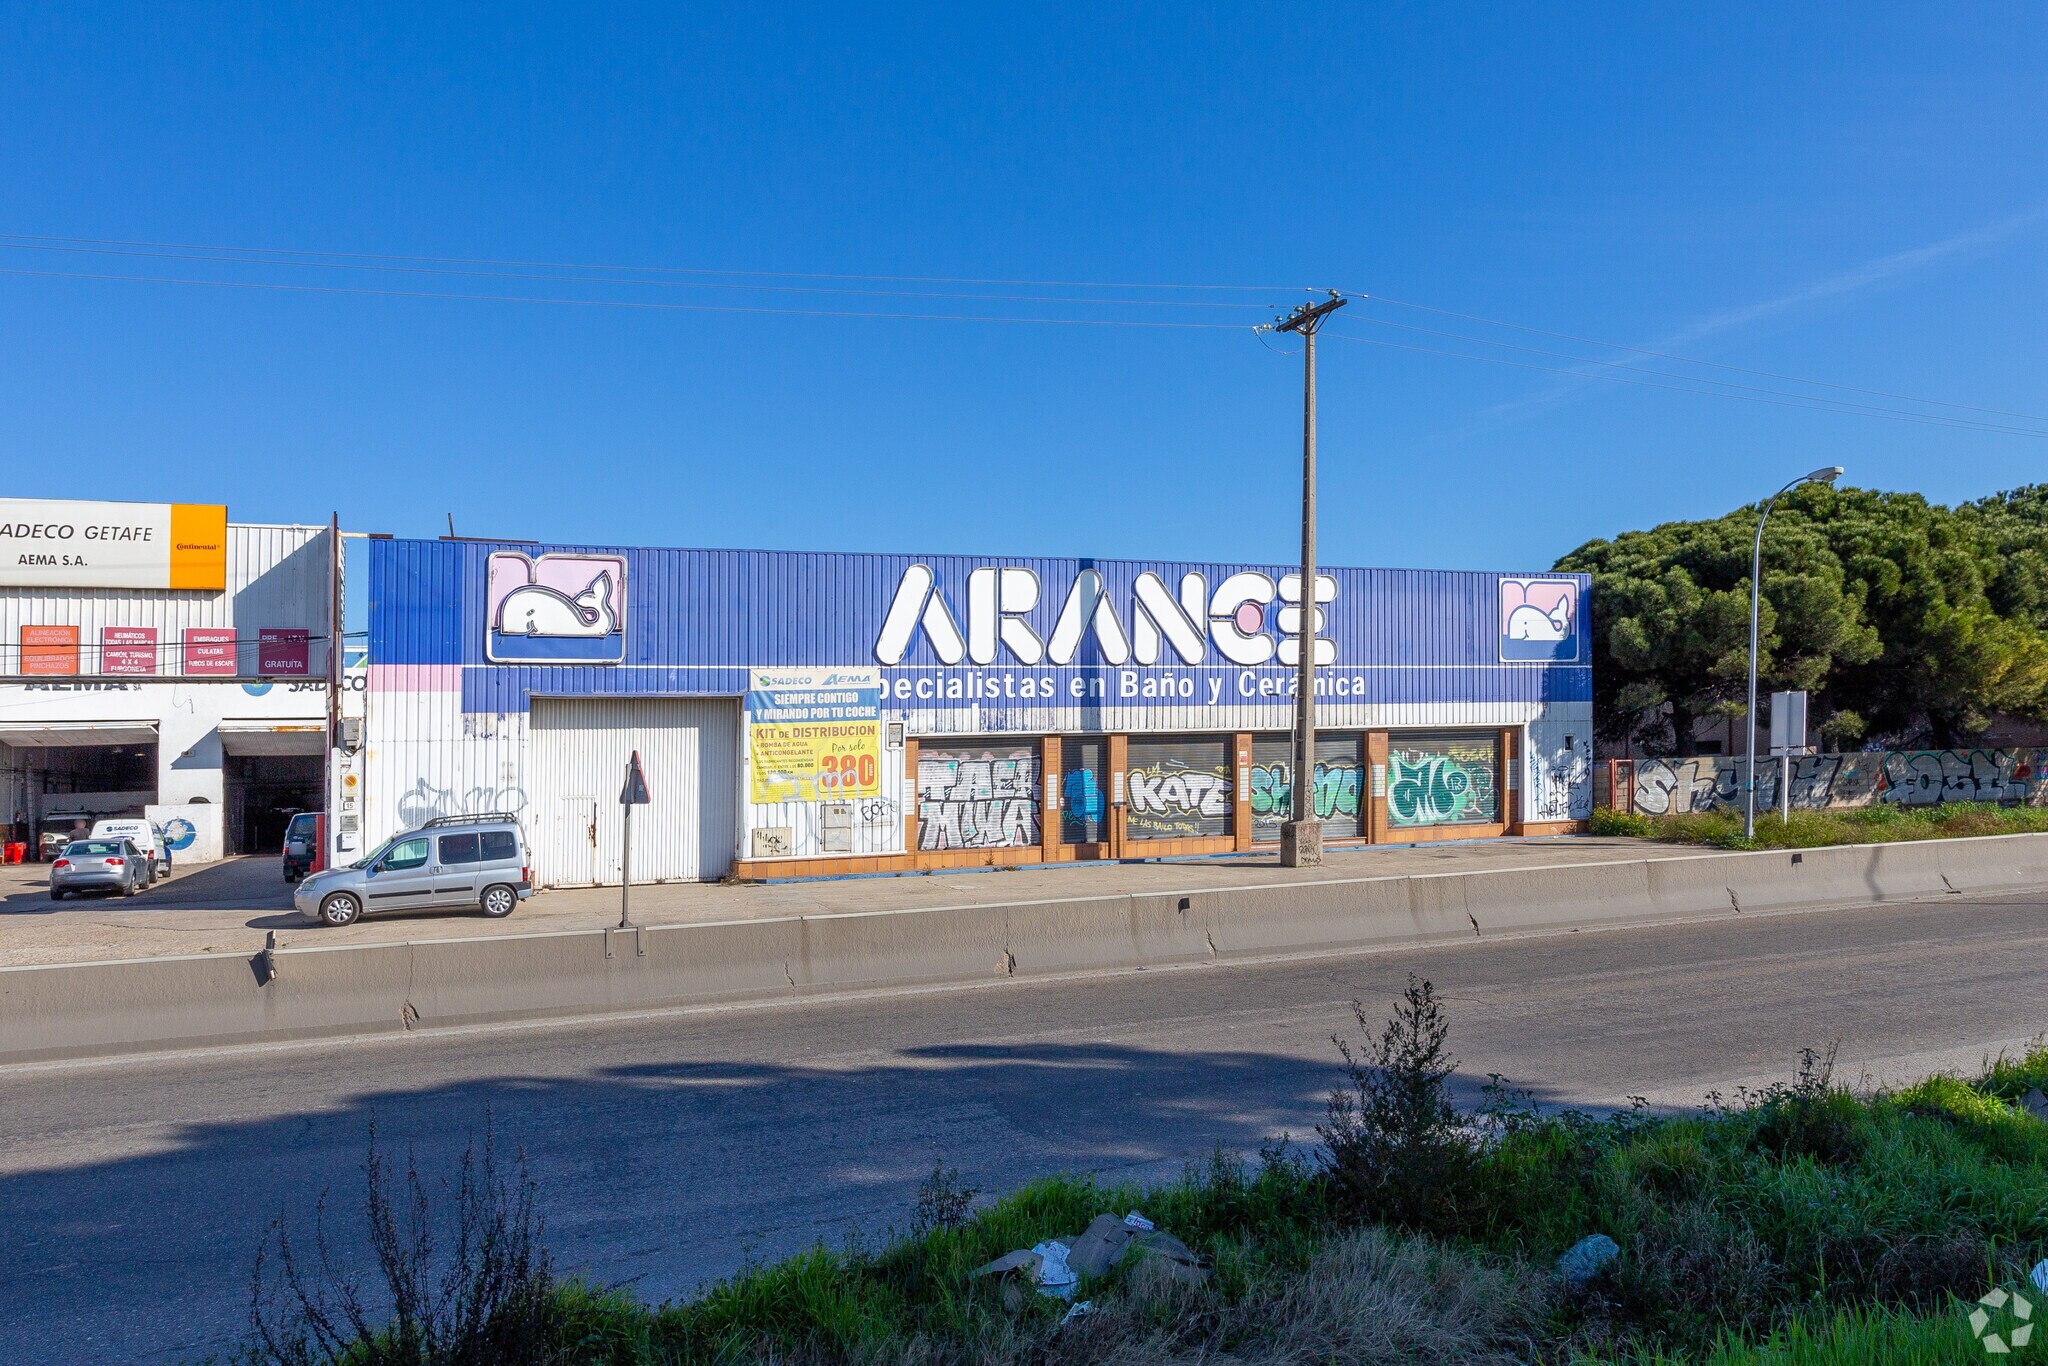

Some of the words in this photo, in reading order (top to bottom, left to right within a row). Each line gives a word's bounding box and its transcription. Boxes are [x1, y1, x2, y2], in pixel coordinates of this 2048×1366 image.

[0, 523, 75, 540] ADECO
[84, 526, 153, 542] GETAFE
[176, 542, 218, 551] Continental
[17, 553, 57, 566] AEMA
[62, 555, 88, 567] S.A.
[873, 563, 1339, 667] ARANCE
[193, 635, 229, 643] EMBRAGUES
[288, 675, 368, 692] SADCO
[771, 677, 812, 686] SADECO
[821, 673, 871, 686] AEMA
[880, 671, 1055, 700] pecialistas
[1069, 677, 1105, 699] en
[1119, 671, 1195, 698] Baño
[1207, 676, 1222, 705] y
[774, 692, 816, 705] SIEMPRE
[817, 691, 859, 704] CONTIGO
[756, 709, 762, 720] Y
[763, 708, 809, 720] MIRANDO
[810, 707, 830, 719] POR
[831, 706, 844, 718] TU
[845, 706, 877, 718] COCHE
[756, 728, 776, 739] KIT
[792, 725, 876, 738] DISTRIBUCION
[831, 742, 847, 754] Por
[848, 739, 866, 751] solo
[821, 753, 875, 788] 380
